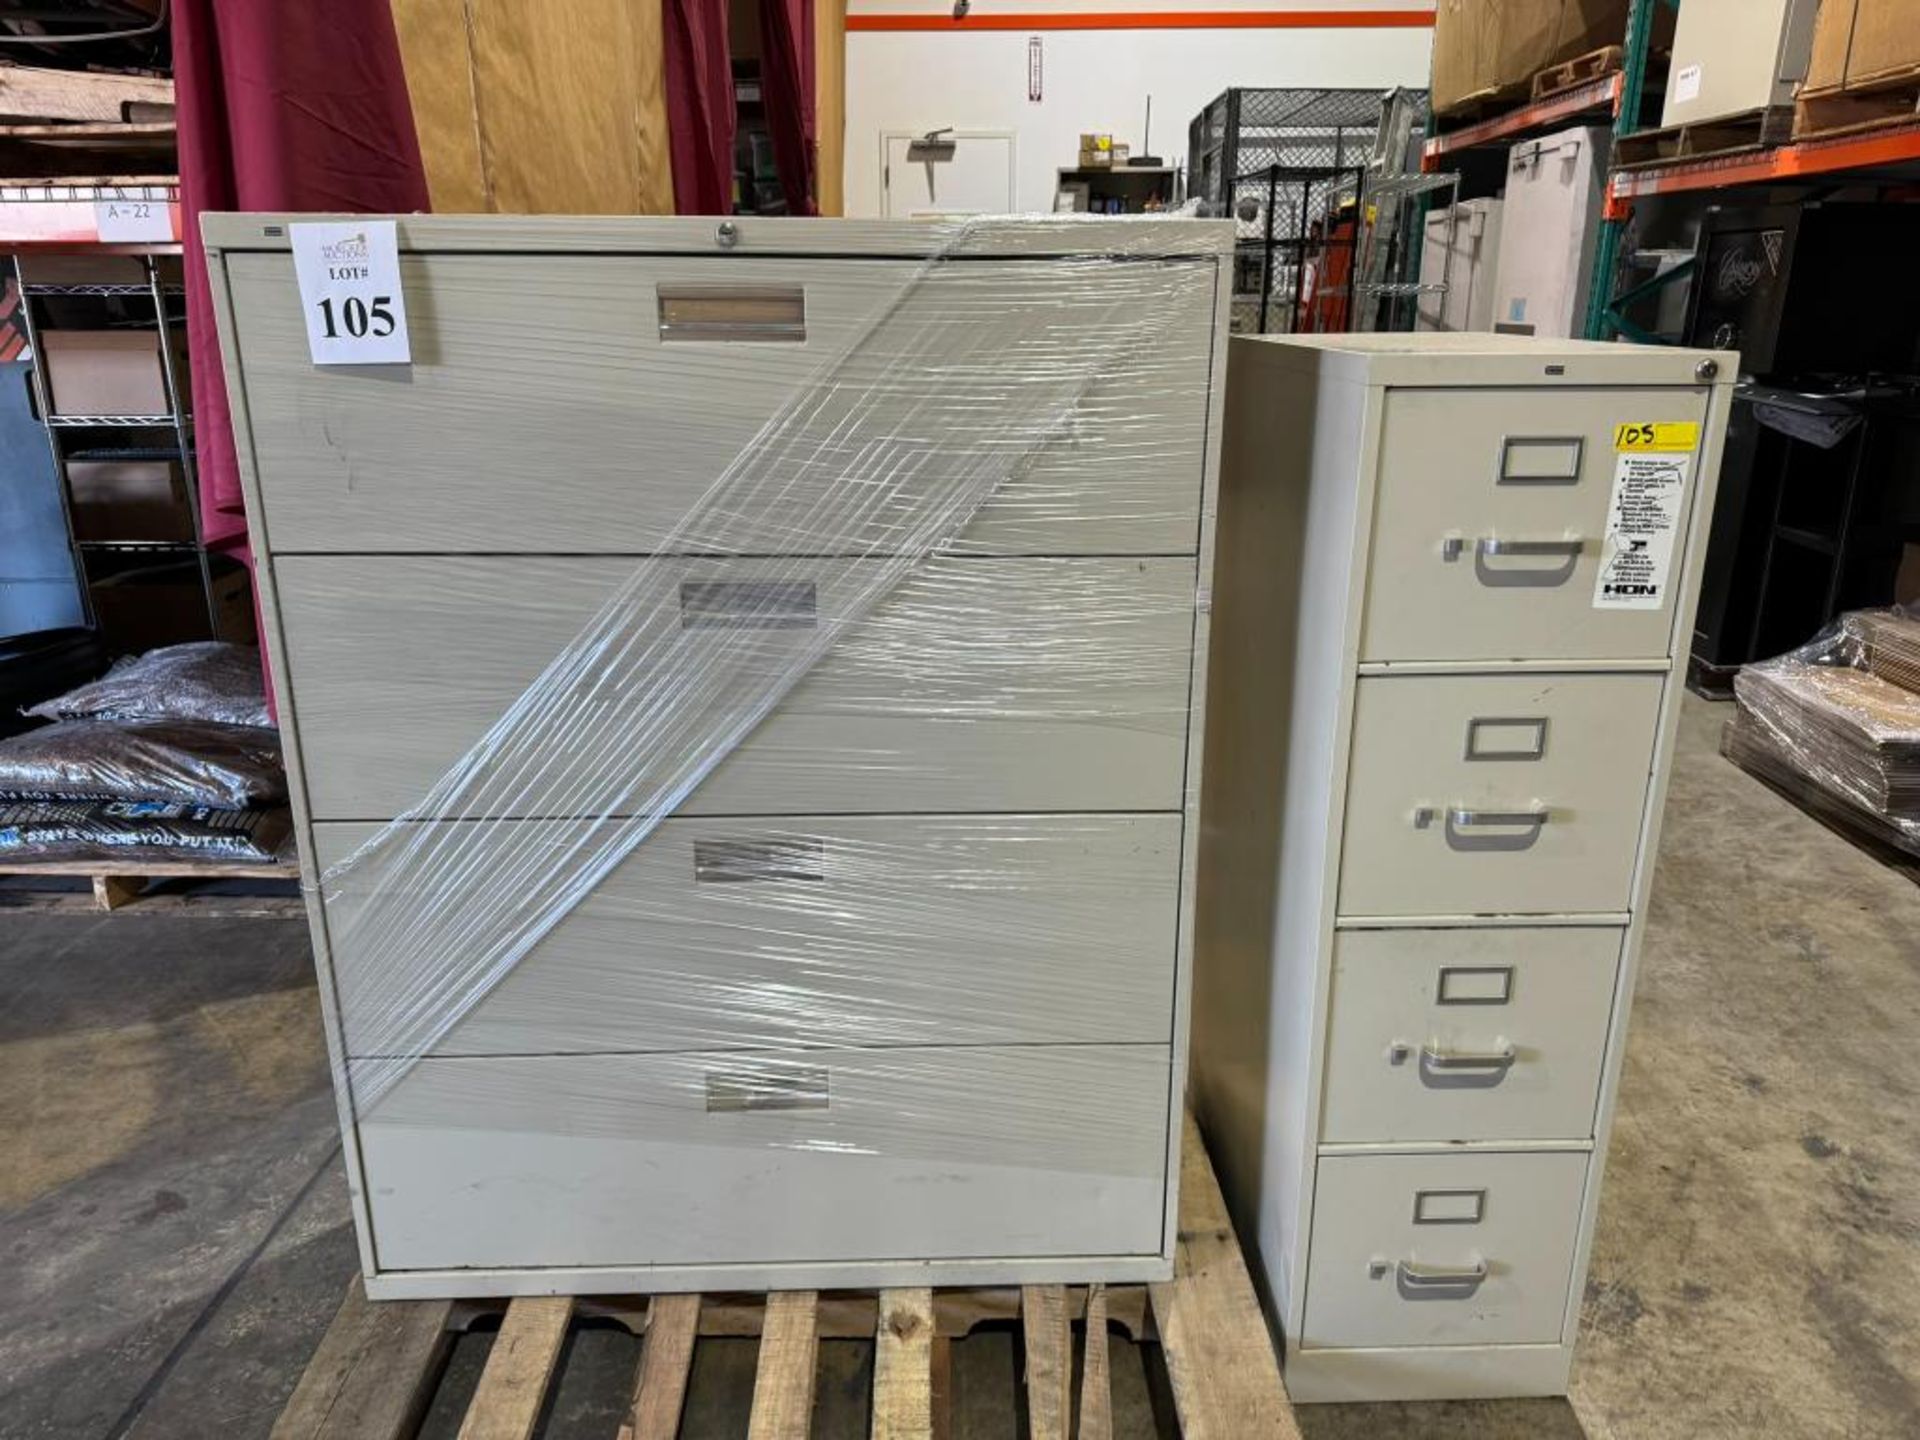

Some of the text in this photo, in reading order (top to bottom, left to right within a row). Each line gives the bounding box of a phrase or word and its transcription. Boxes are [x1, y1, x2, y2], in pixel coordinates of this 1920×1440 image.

[133, 203, 151, 218] 22
[329, 266, 369, 280] LOT#
[317, 295, 396, 338] 105
[1616, 424, 1655, 447] 105
[1603, 584, 1657, 595] HON
[140, 833, 174, 846] YOU
[180, 834, 210, 847] PUT
